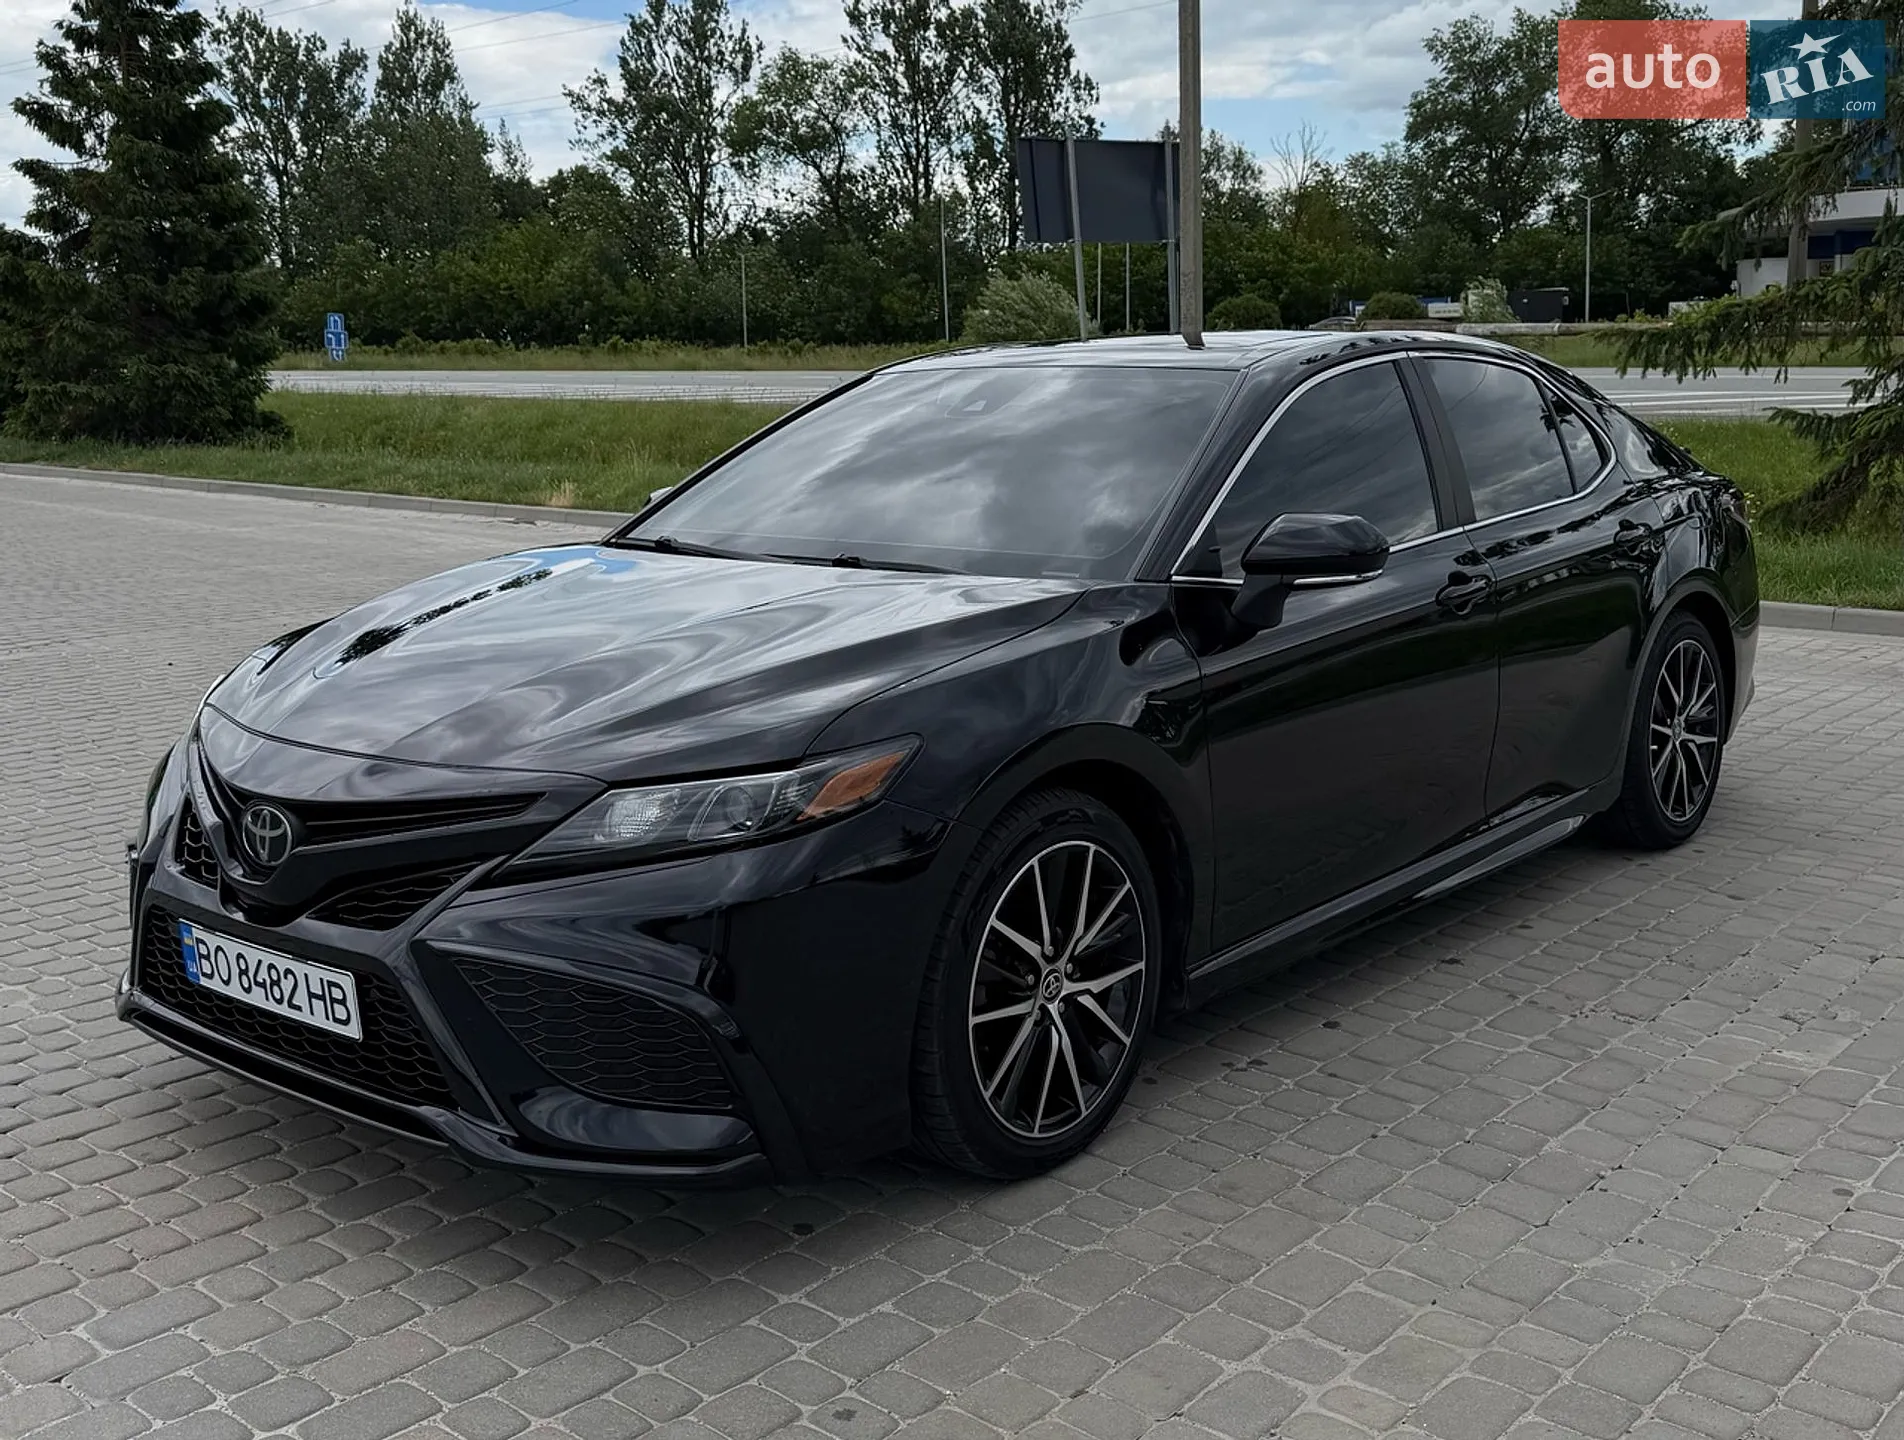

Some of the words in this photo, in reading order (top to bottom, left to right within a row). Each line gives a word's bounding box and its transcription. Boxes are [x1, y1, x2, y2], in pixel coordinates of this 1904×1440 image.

[195, 936, 231, 987] BO
[236, 952, 303, 1012] 8482
[304, 973, 351, 1027] HB
